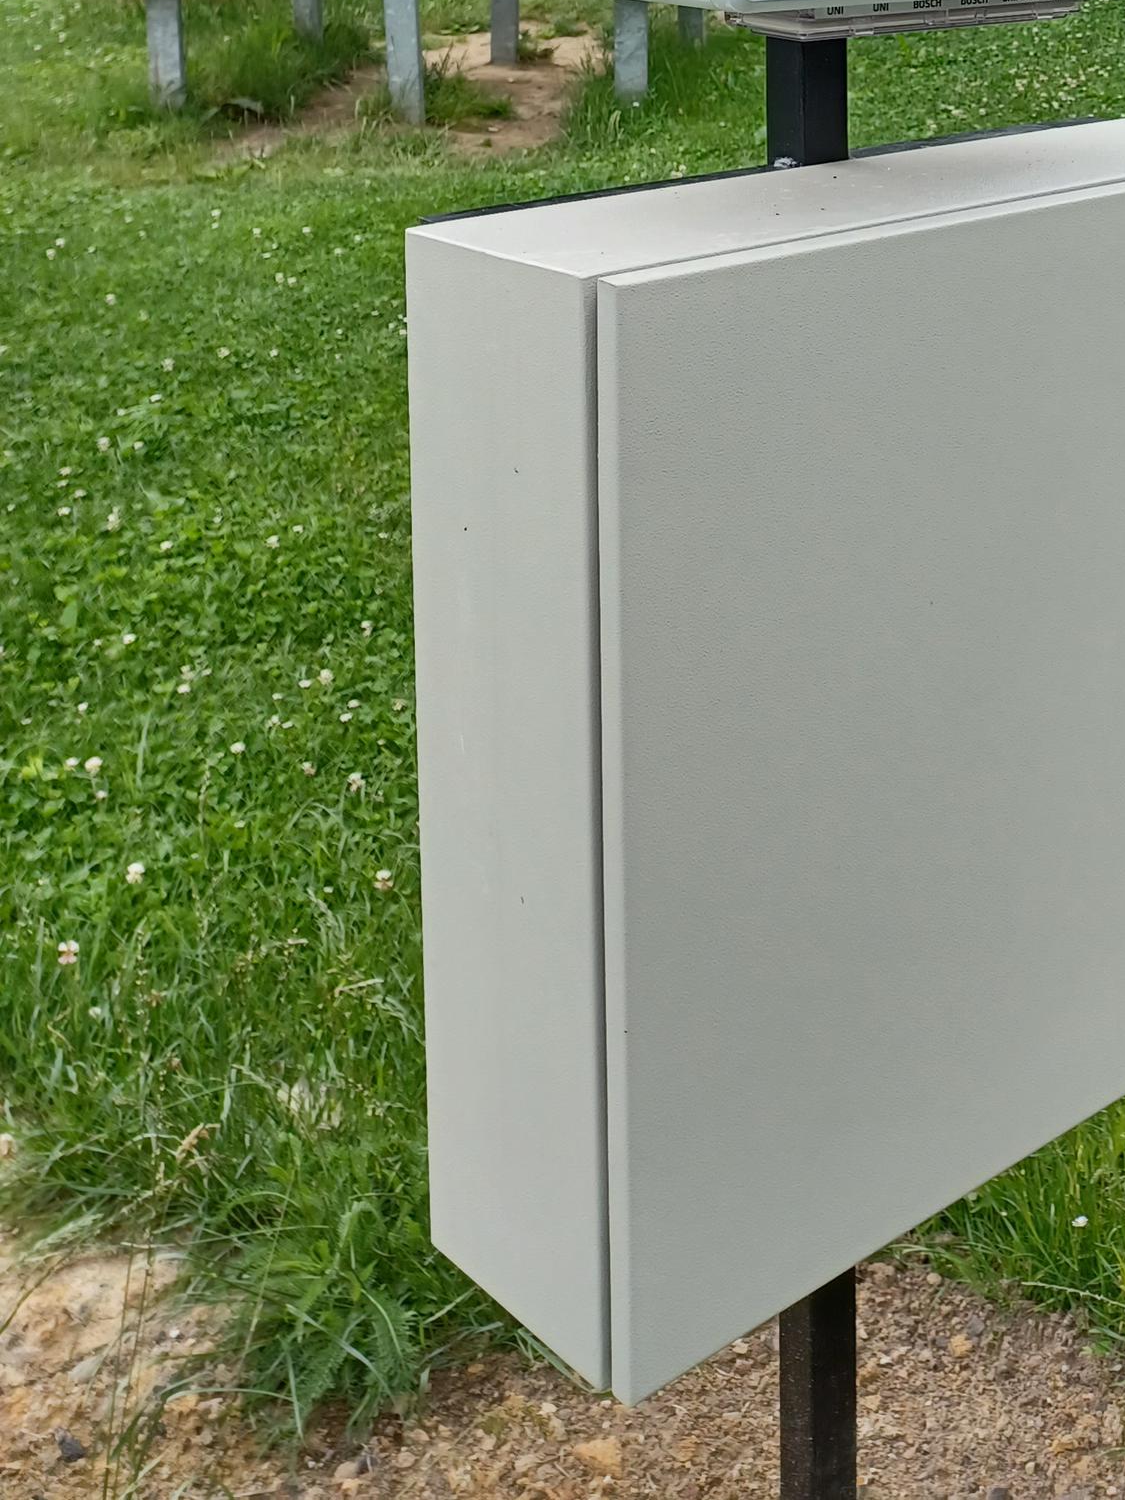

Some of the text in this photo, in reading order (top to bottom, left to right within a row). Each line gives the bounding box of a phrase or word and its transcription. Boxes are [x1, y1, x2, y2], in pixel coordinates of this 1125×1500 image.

[827, 6, 844, 16] UNI
[873, 3, 890, 12] UNI
[913, 0, 942, 9] BOSCH
